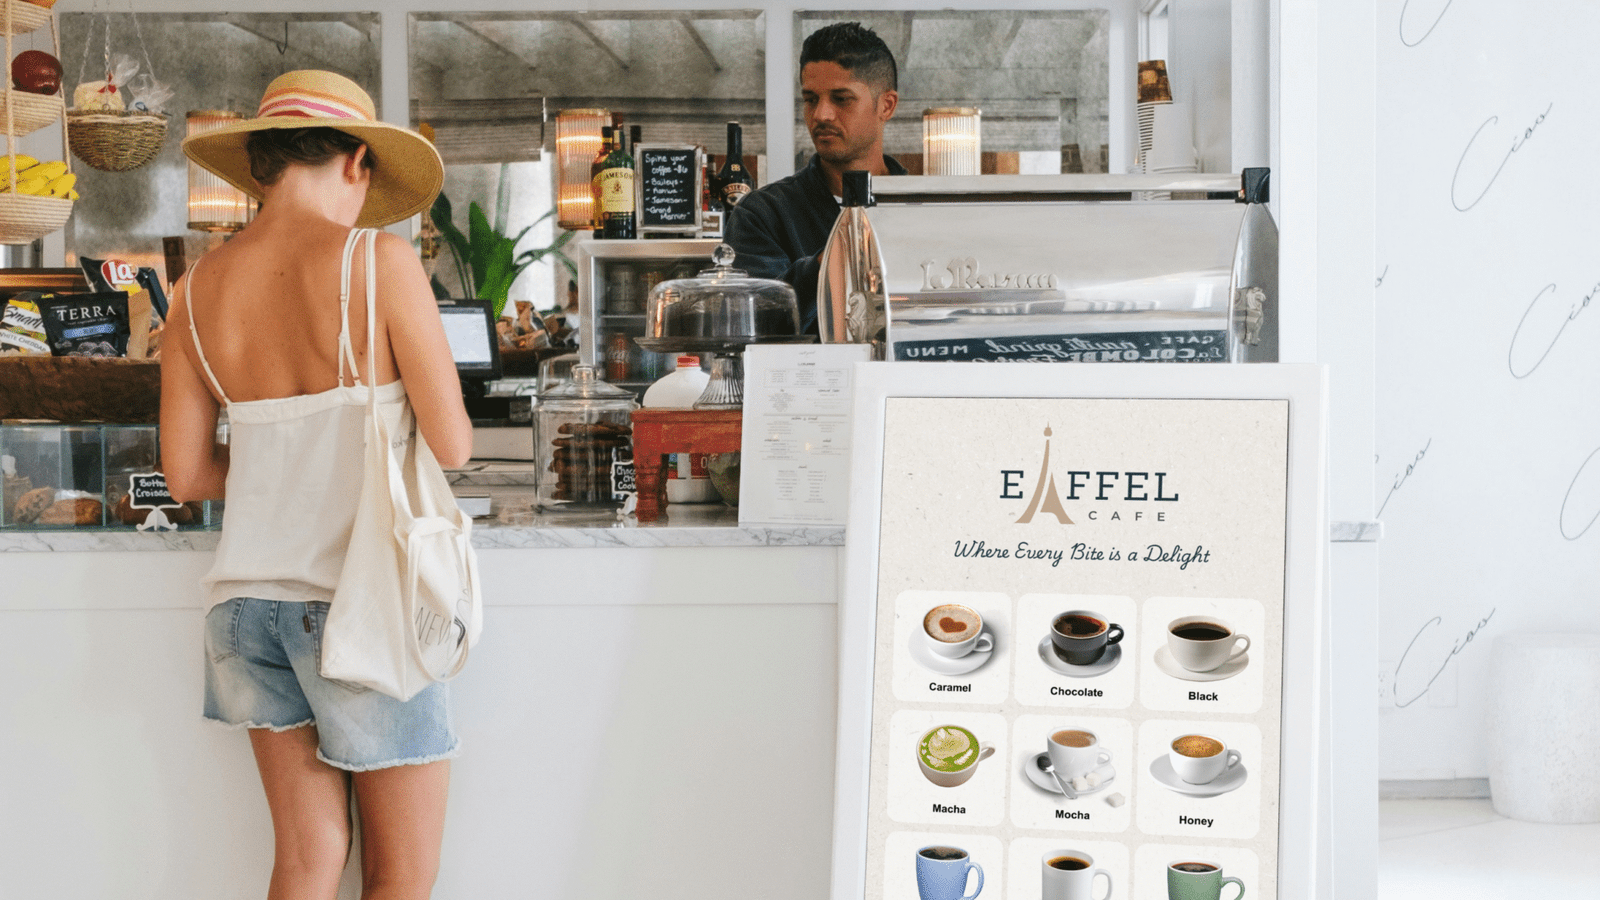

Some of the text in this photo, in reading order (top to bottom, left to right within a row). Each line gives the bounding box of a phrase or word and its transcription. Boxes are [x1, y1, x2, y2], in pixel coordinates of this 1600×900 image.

[670, 155, 688, 166] your
[651, 165, 673, 176] coffee
[107, 261, 135, 284] La
[56, 305, 117, 322] TERRA
[1376, 438, 1432, 519] iao
[136, 488, 171, 498] Croissa
[1088, 510, 1166, 522] CAFE
[954, 540, 1211, 571] Where Every Bite is a Delight
[928, 682, 972, 693] Caramel
[1050, 686, 1104, 698] Chocolate
[1188, 691, 1219, 702] Black
[932, 804, 967, 815] Macha
[1055, 809, 1091, 820] Mocha
[1178, 815, 1214, 828] Honey
